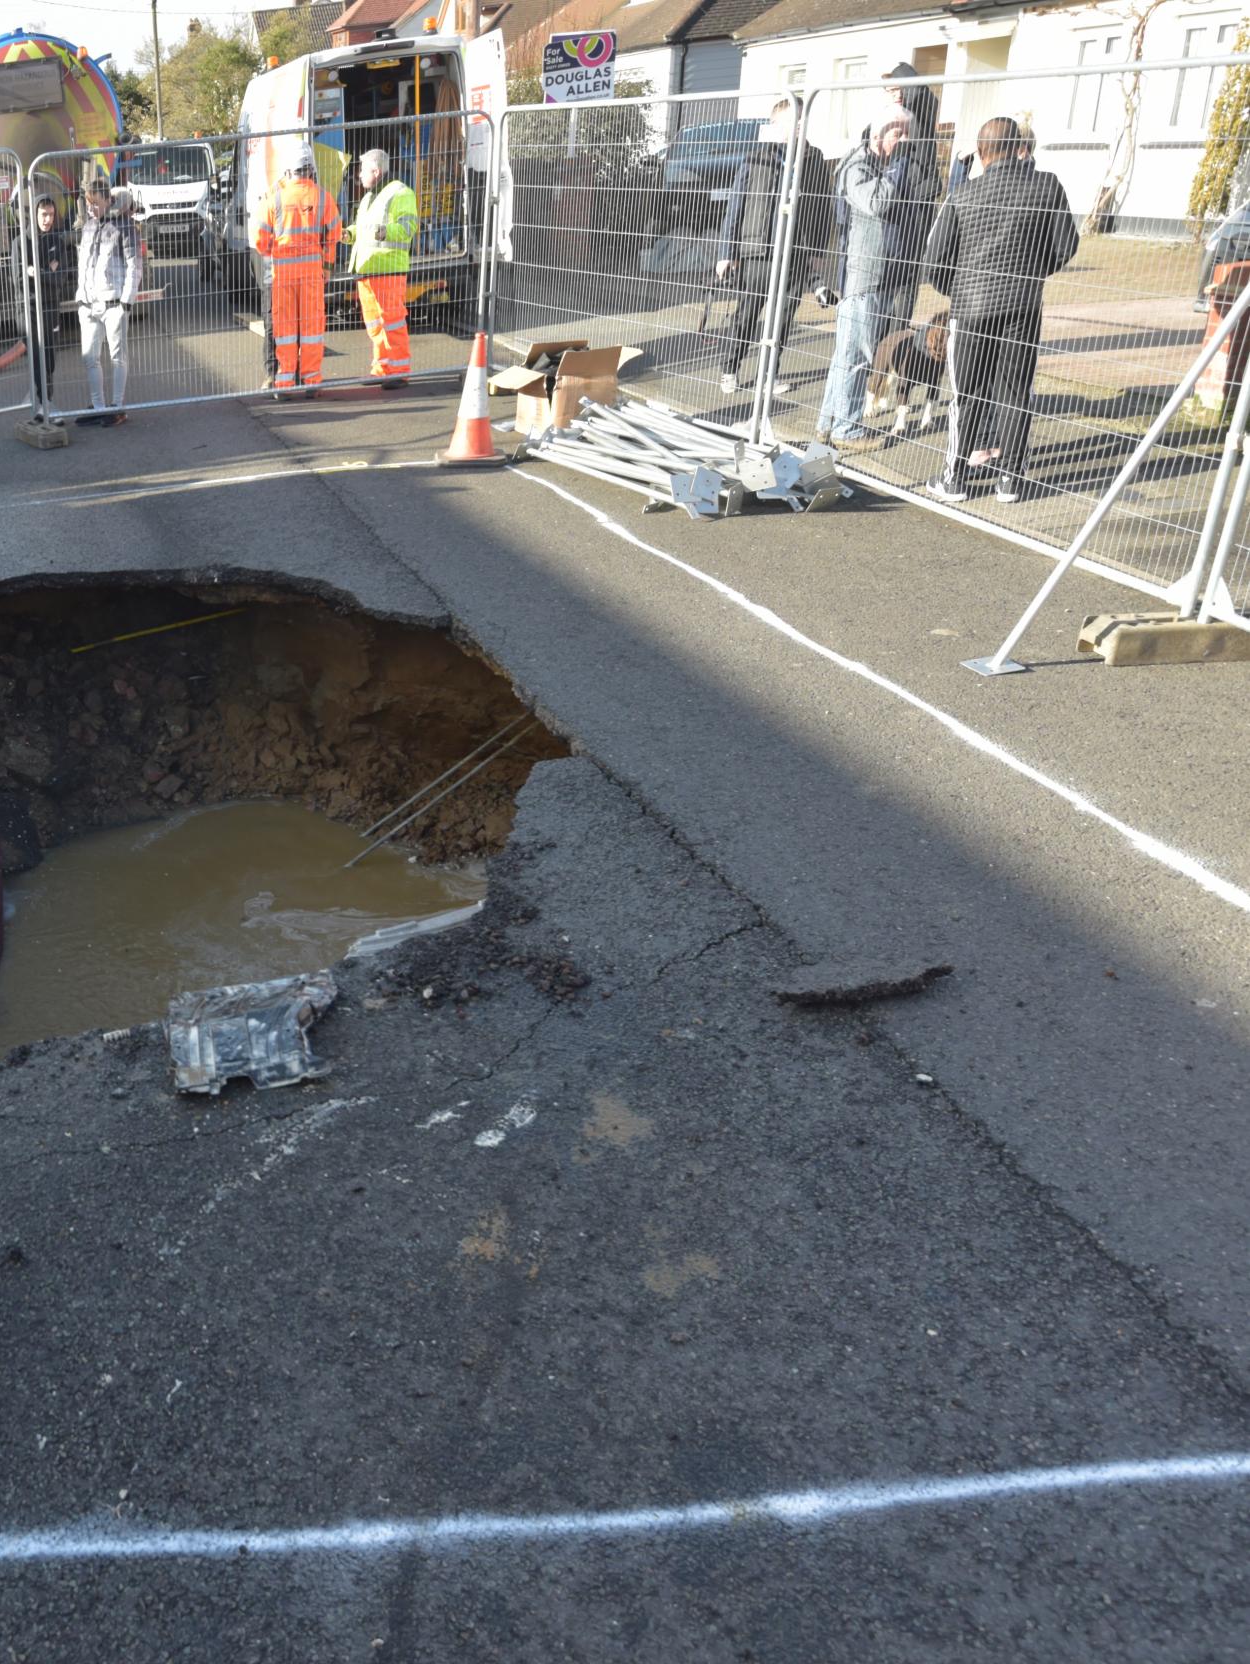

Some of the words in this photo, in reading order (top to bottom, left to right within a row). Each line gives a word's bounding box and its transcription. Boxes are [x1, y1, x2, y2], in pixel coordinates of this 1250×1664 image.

[546, 48, 560, 56] For
[546, 56, 563, 64] Sale
[545, 66, 611, 87] DOUGLAS
[566, 79, 611, 96] ALLEN
